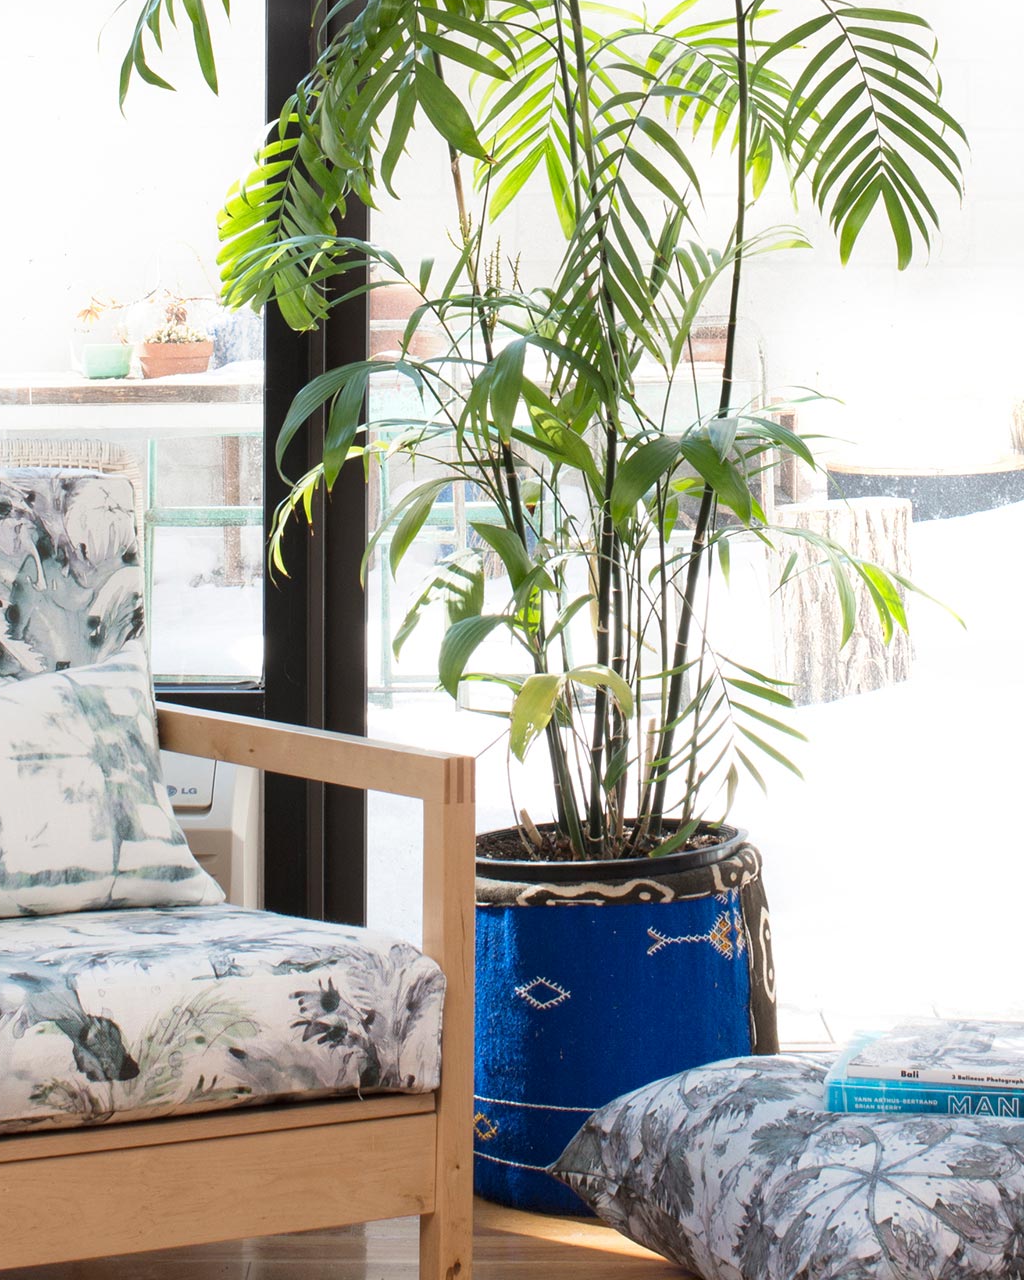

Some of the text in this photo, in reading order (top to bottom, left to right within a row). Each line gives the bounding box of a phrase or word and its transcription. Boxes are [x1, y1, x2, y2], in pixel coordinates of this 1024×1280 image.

[900, 1070, 919, 1079] Bali
[957, 1074, 985, 1082] Balinese
[948, 1095, 1019, 1119] MAN
